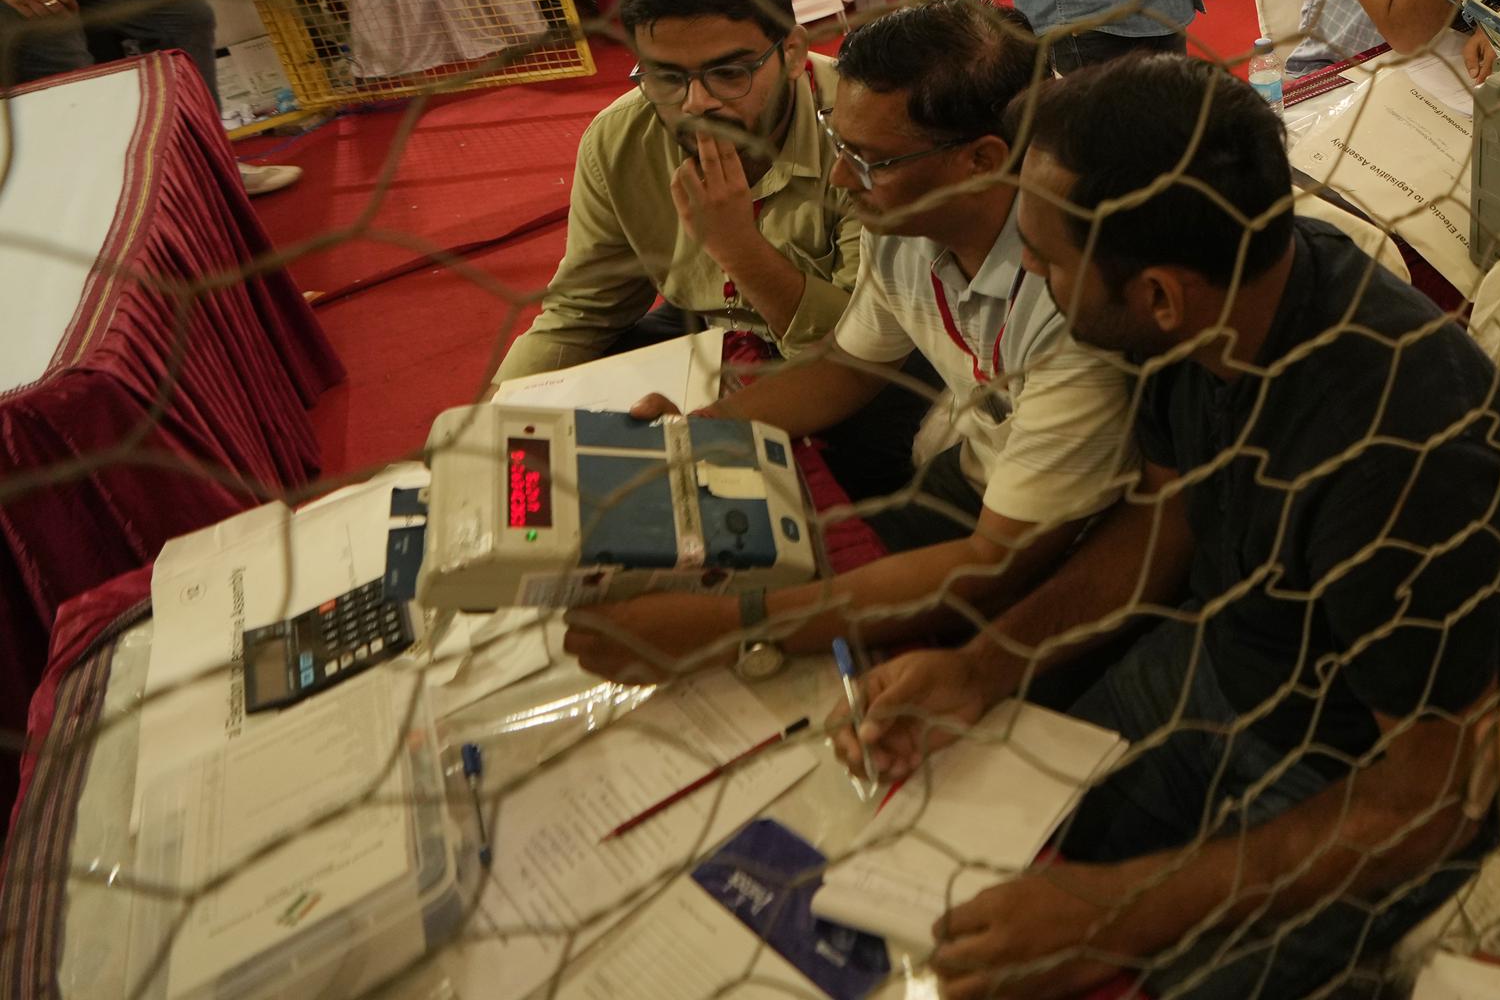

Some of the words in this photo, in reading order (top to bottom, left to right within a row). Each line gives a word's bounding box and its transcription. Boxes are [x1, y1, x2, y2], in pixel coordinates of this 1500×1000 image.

[1409, 88, 1444, 119] (Form-17C)
[1441, 111, 1470, 137] recorded
[1331, 137, 1371, 168] Assembly
[1370, 164, 1415, 198] Legislative
[1414, 194, 1425, 204] to
